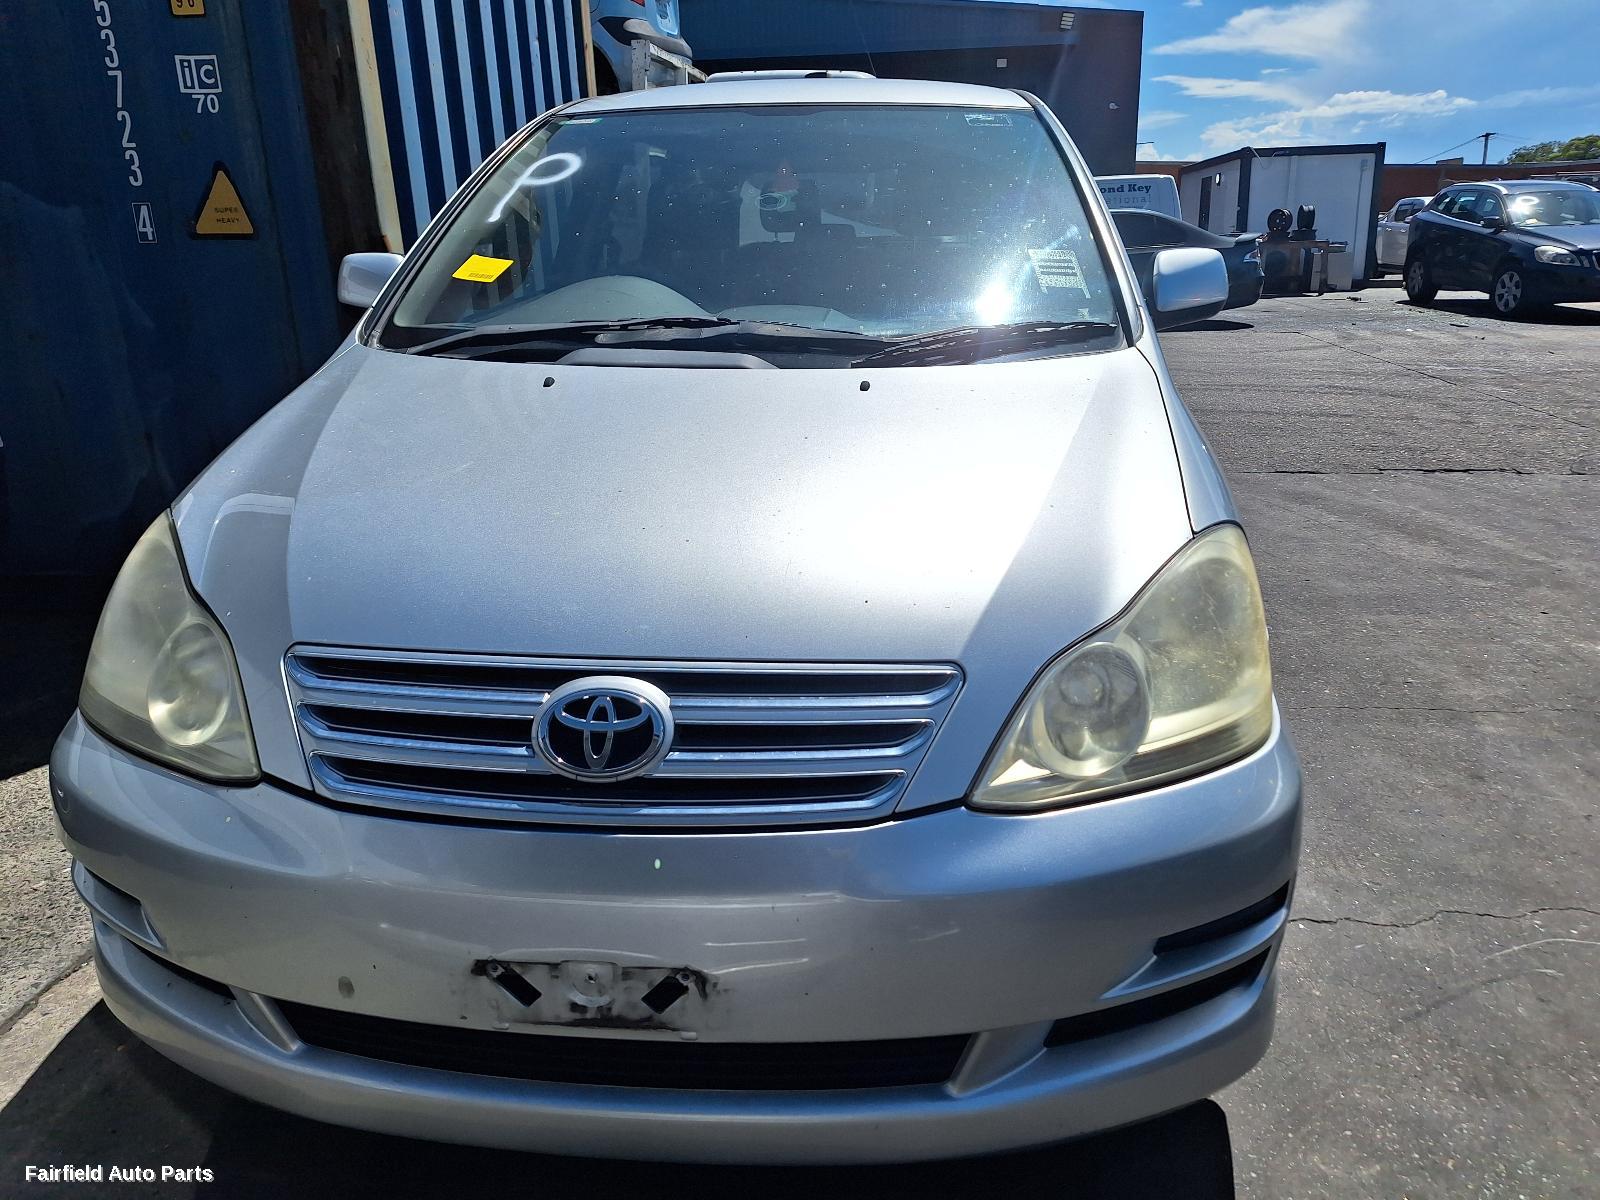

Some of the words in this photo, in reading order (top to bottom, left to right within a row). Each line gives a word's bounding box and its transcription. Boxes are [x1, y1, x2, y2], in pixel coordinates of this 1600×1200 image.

[191, 94, 219, 114] 70
[1127, 183, 1152, 194] Key
[138, 204, 153, 241] 4
